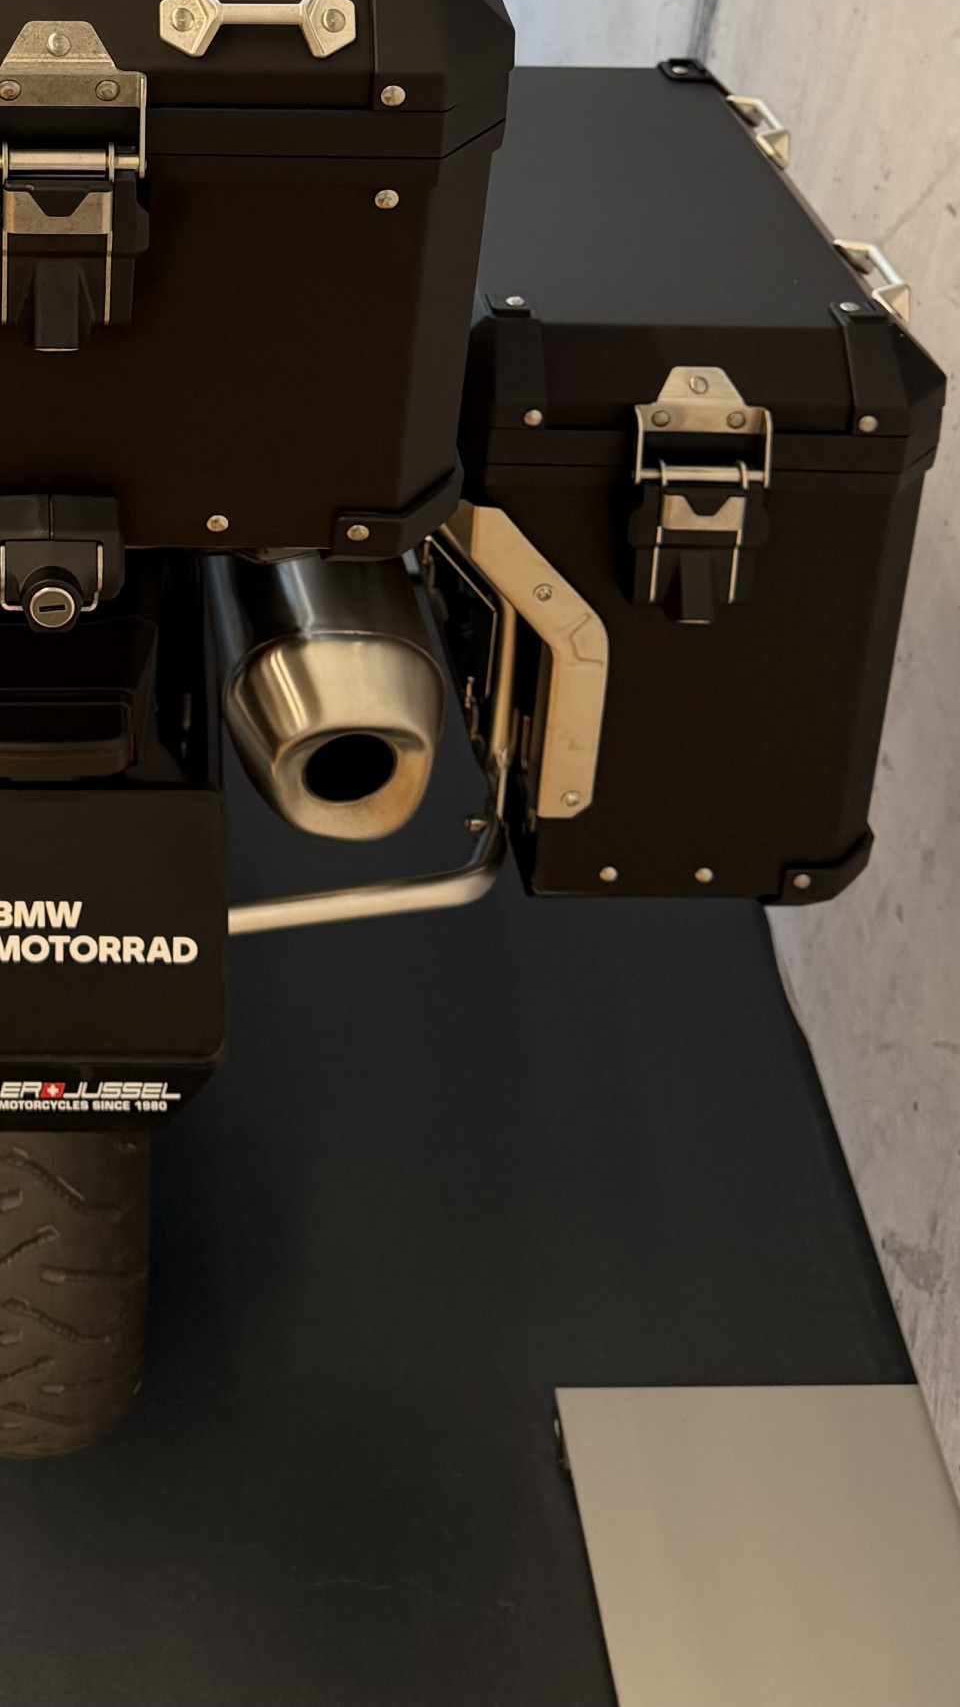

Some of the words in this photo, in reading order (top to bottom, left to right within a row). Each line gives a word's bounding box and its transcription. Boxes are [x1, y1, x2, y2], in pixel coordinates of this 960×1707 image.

[63, 1081, 182, 1100] JUSSEL
[92, 1100, 131, 1112] SINCE
[134, 1100, 168, 1112] 1980
